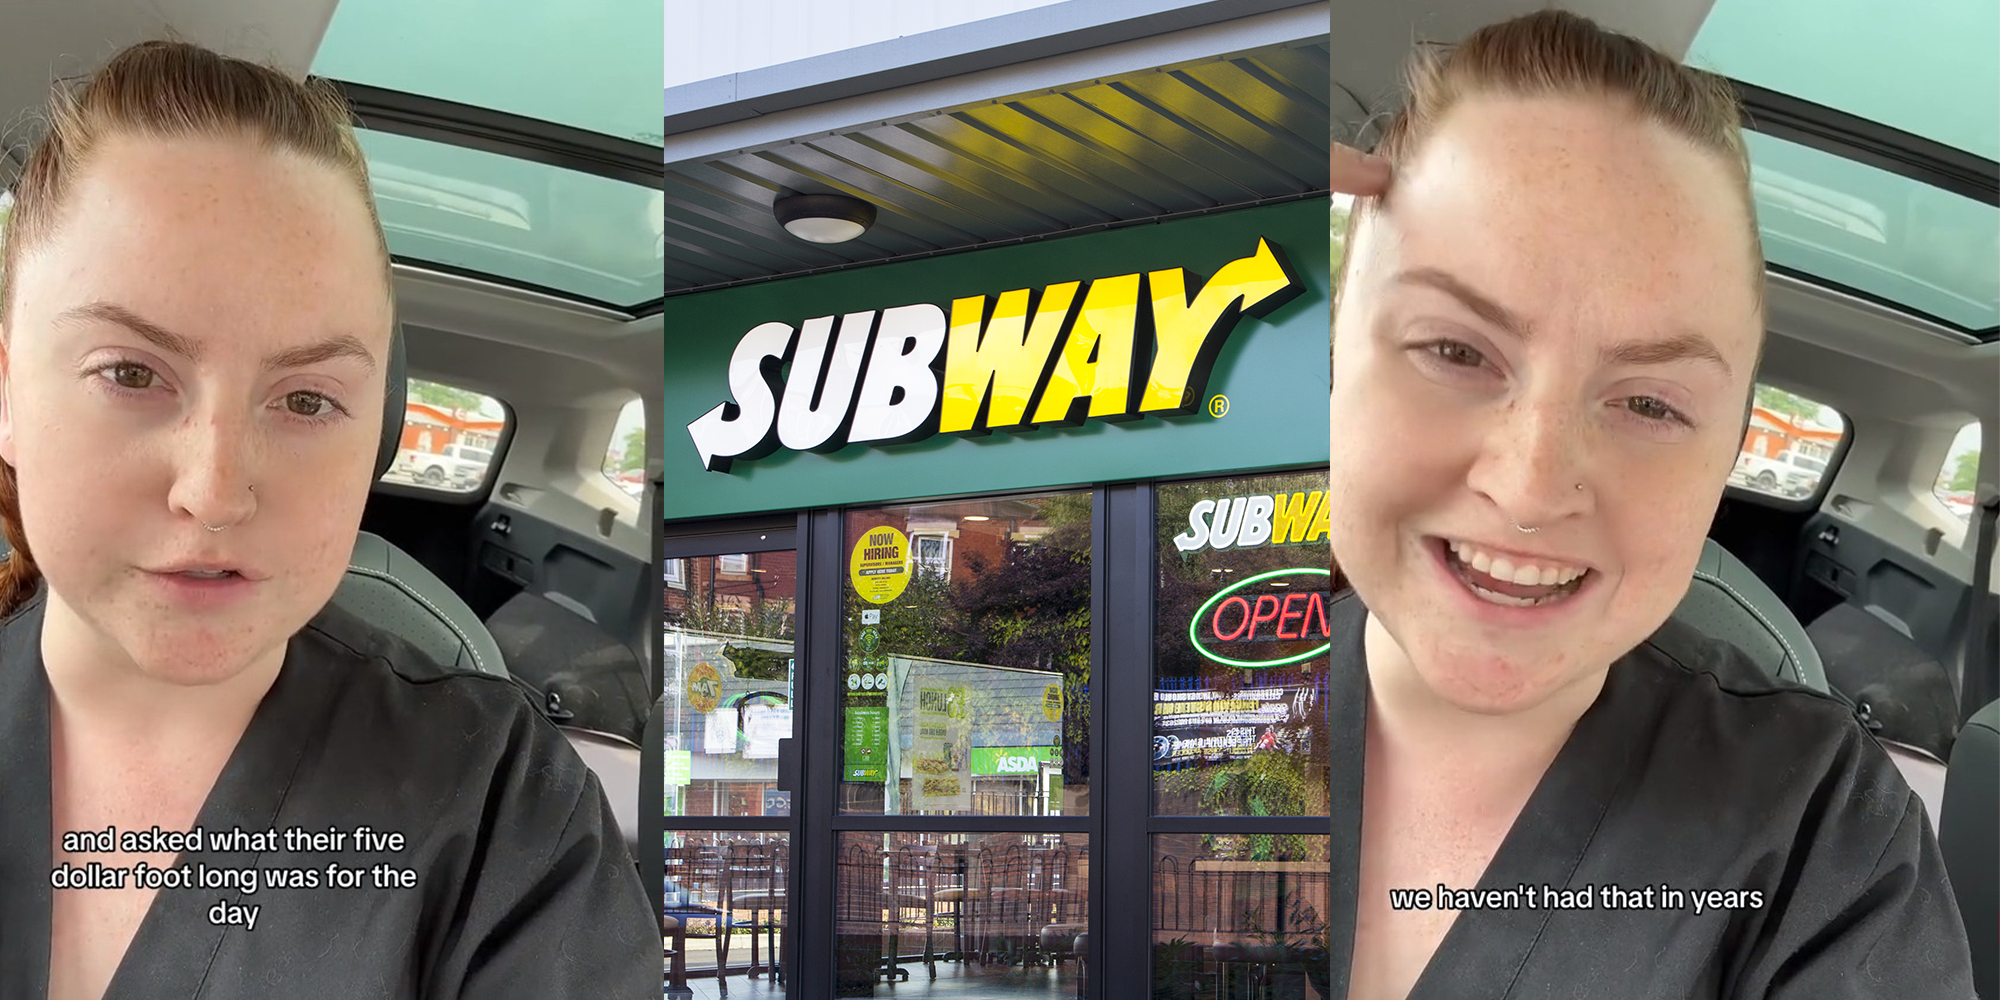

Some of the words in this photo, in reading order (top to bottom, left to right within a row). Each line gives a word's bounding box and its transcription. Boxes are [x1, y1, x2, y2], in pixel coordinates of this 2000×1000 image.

[687, 235, 1306, 472] SUBWAY
[869, 532, 895, 547] NOW
[863, 546, 899, 561] HIRING
[1212, 592, 1330, 642] OPEN
[852, 768, 879, 777] SUBWAY
[996, 756, 1038, 773] ASDA
